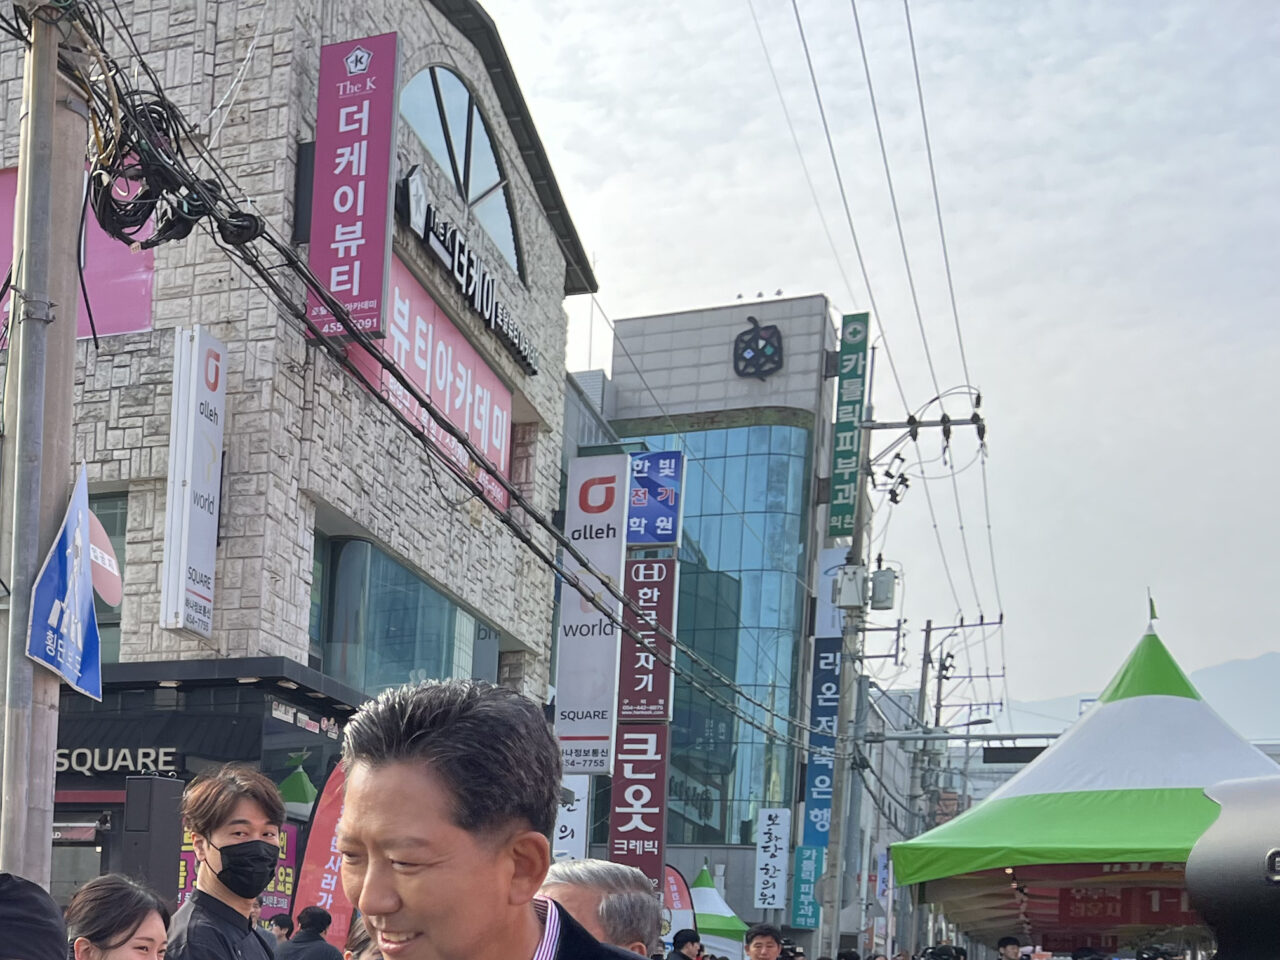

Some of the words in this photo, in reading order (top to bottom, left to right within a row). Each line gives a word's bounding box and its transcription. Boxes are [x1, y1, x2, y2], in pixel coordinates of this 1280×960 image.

[336, 83, 362, 97] The
[365, 77, 377, 91] K
[330, 99, 370, 297] 더케이뷰티
[453, 228, 498, 330] 더케이
[390, 286, 508, 472] 뷰티아카데미
[199, 400, 219, 426] olleh
[632, 458, 676, 478] 한빛
[192, 489, 215, 516] world
[631, 487, 675, 507] 전기
[571, 523, 617, 541] olleh
[629, 516, 673, 535] 학원
[186, 566, 212, 591] SQUARE
[563, 618, 615, 638] world
[560, 710, 609, 724] SQUARE
[54, 747, 177, 773] SQUARE
[564, 759, 606, 768] 54-7755
[615, 732, 662, 833] 큰옷
[613, 839, 659, 856] 크레빅
